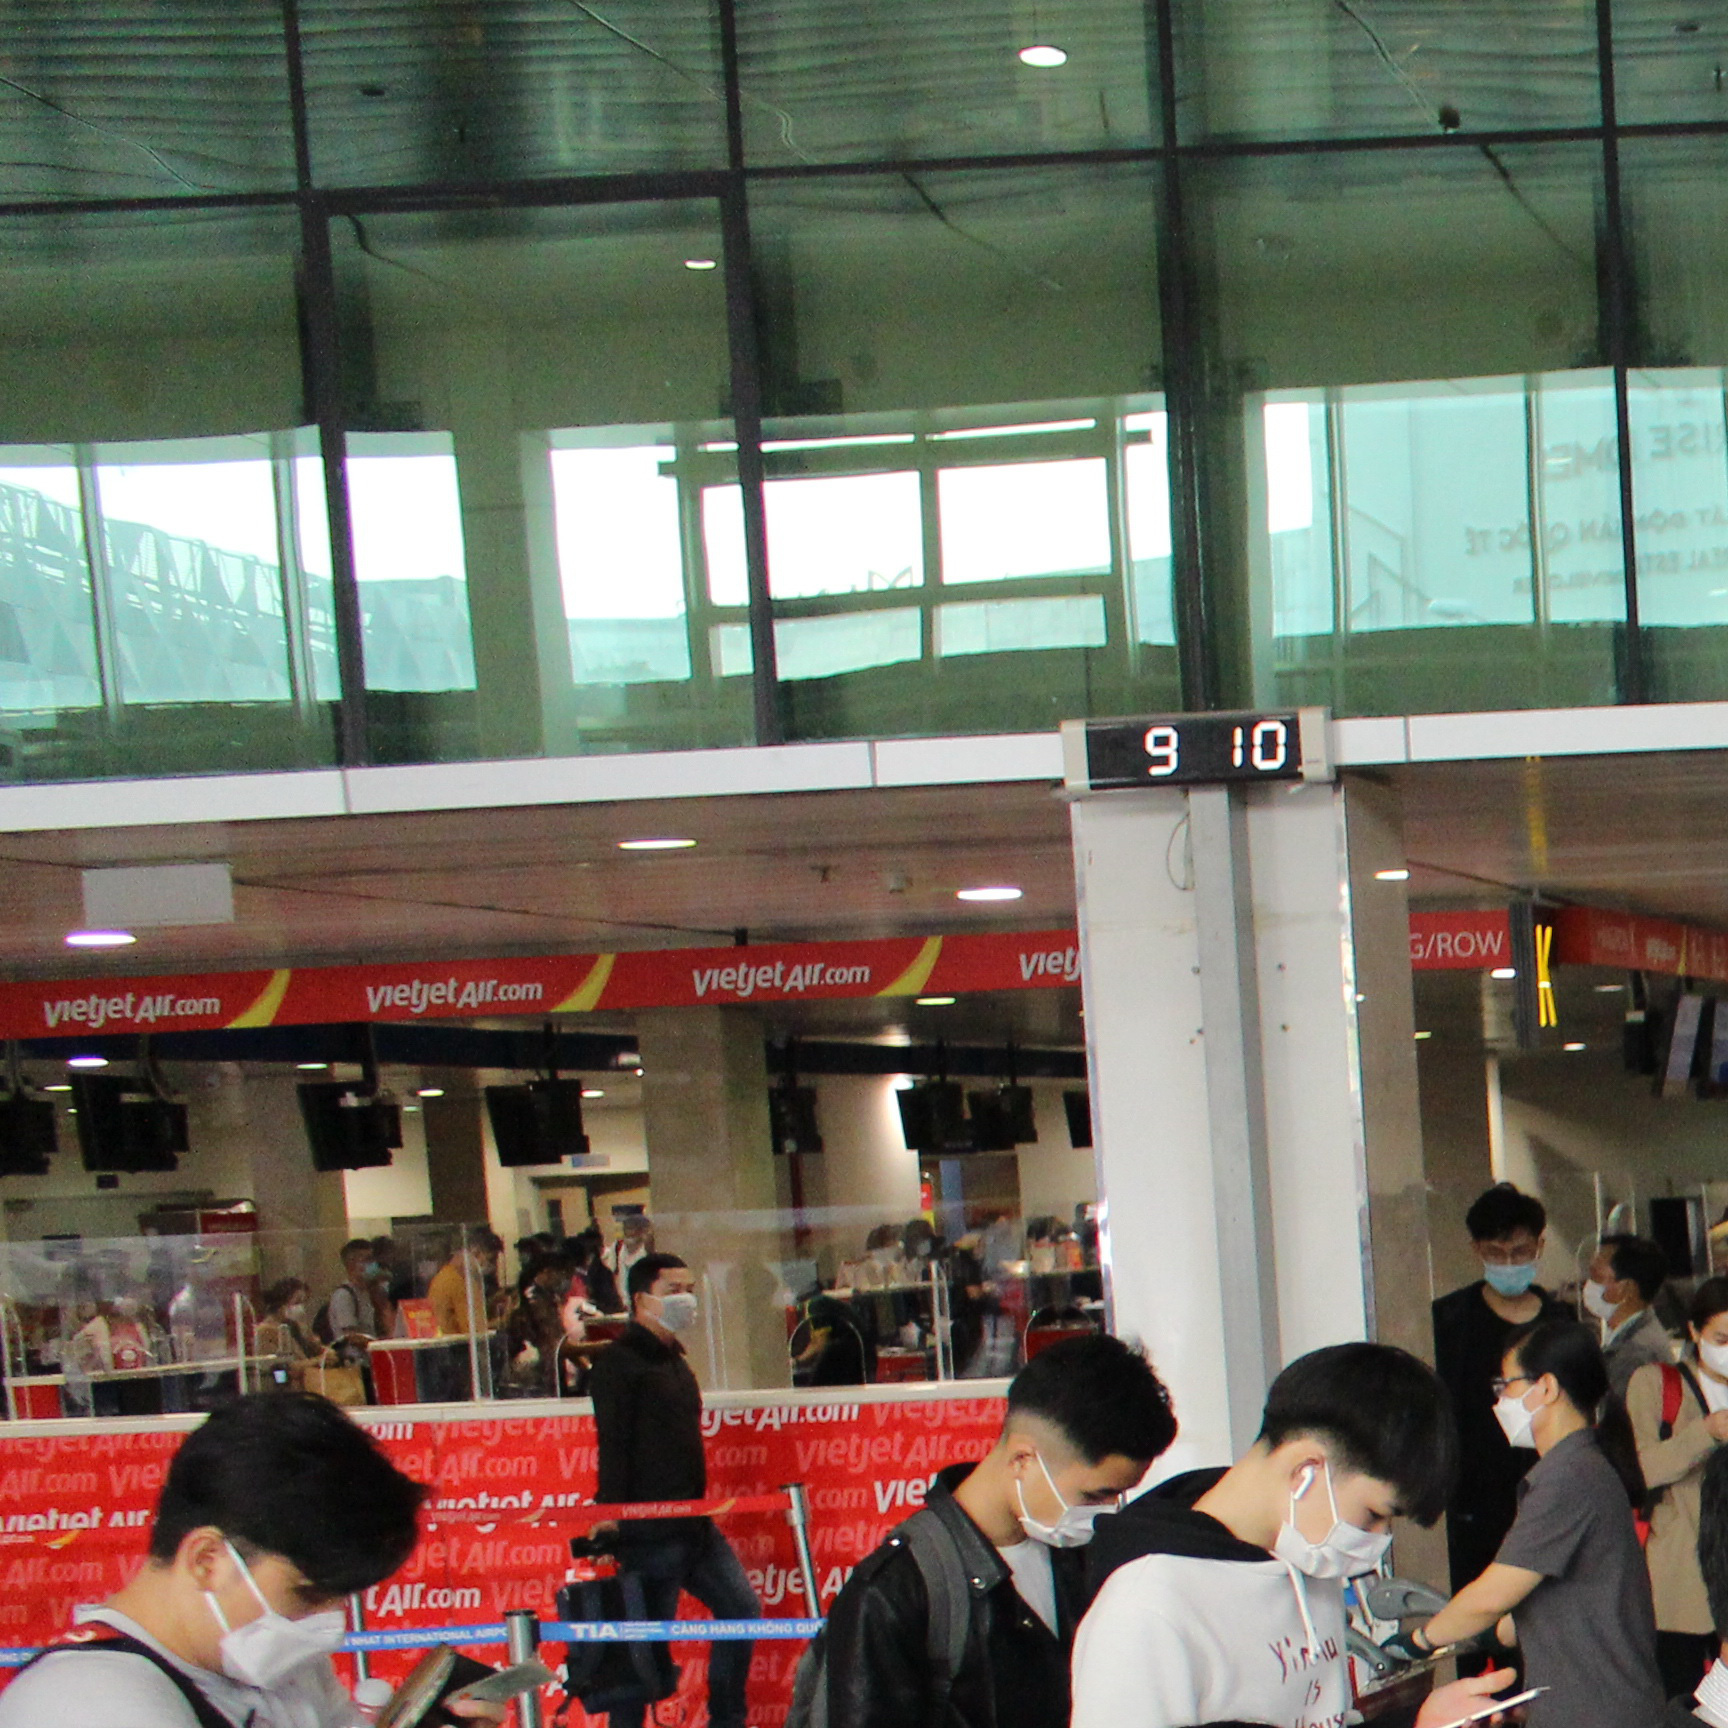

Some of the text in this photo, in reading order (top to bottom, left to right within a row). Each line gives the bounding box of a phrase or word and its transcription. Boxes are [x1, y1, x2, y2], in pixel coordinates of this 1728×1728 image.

[1144, 720, 1287, 777] 9 10
[1409, 929, 1503, 960] G/ROW
[474, 1625, 508, 1639] AIRPO
[570, 1622, 618, 1640] TIA
[795, 1617, 824, 1632] QU
